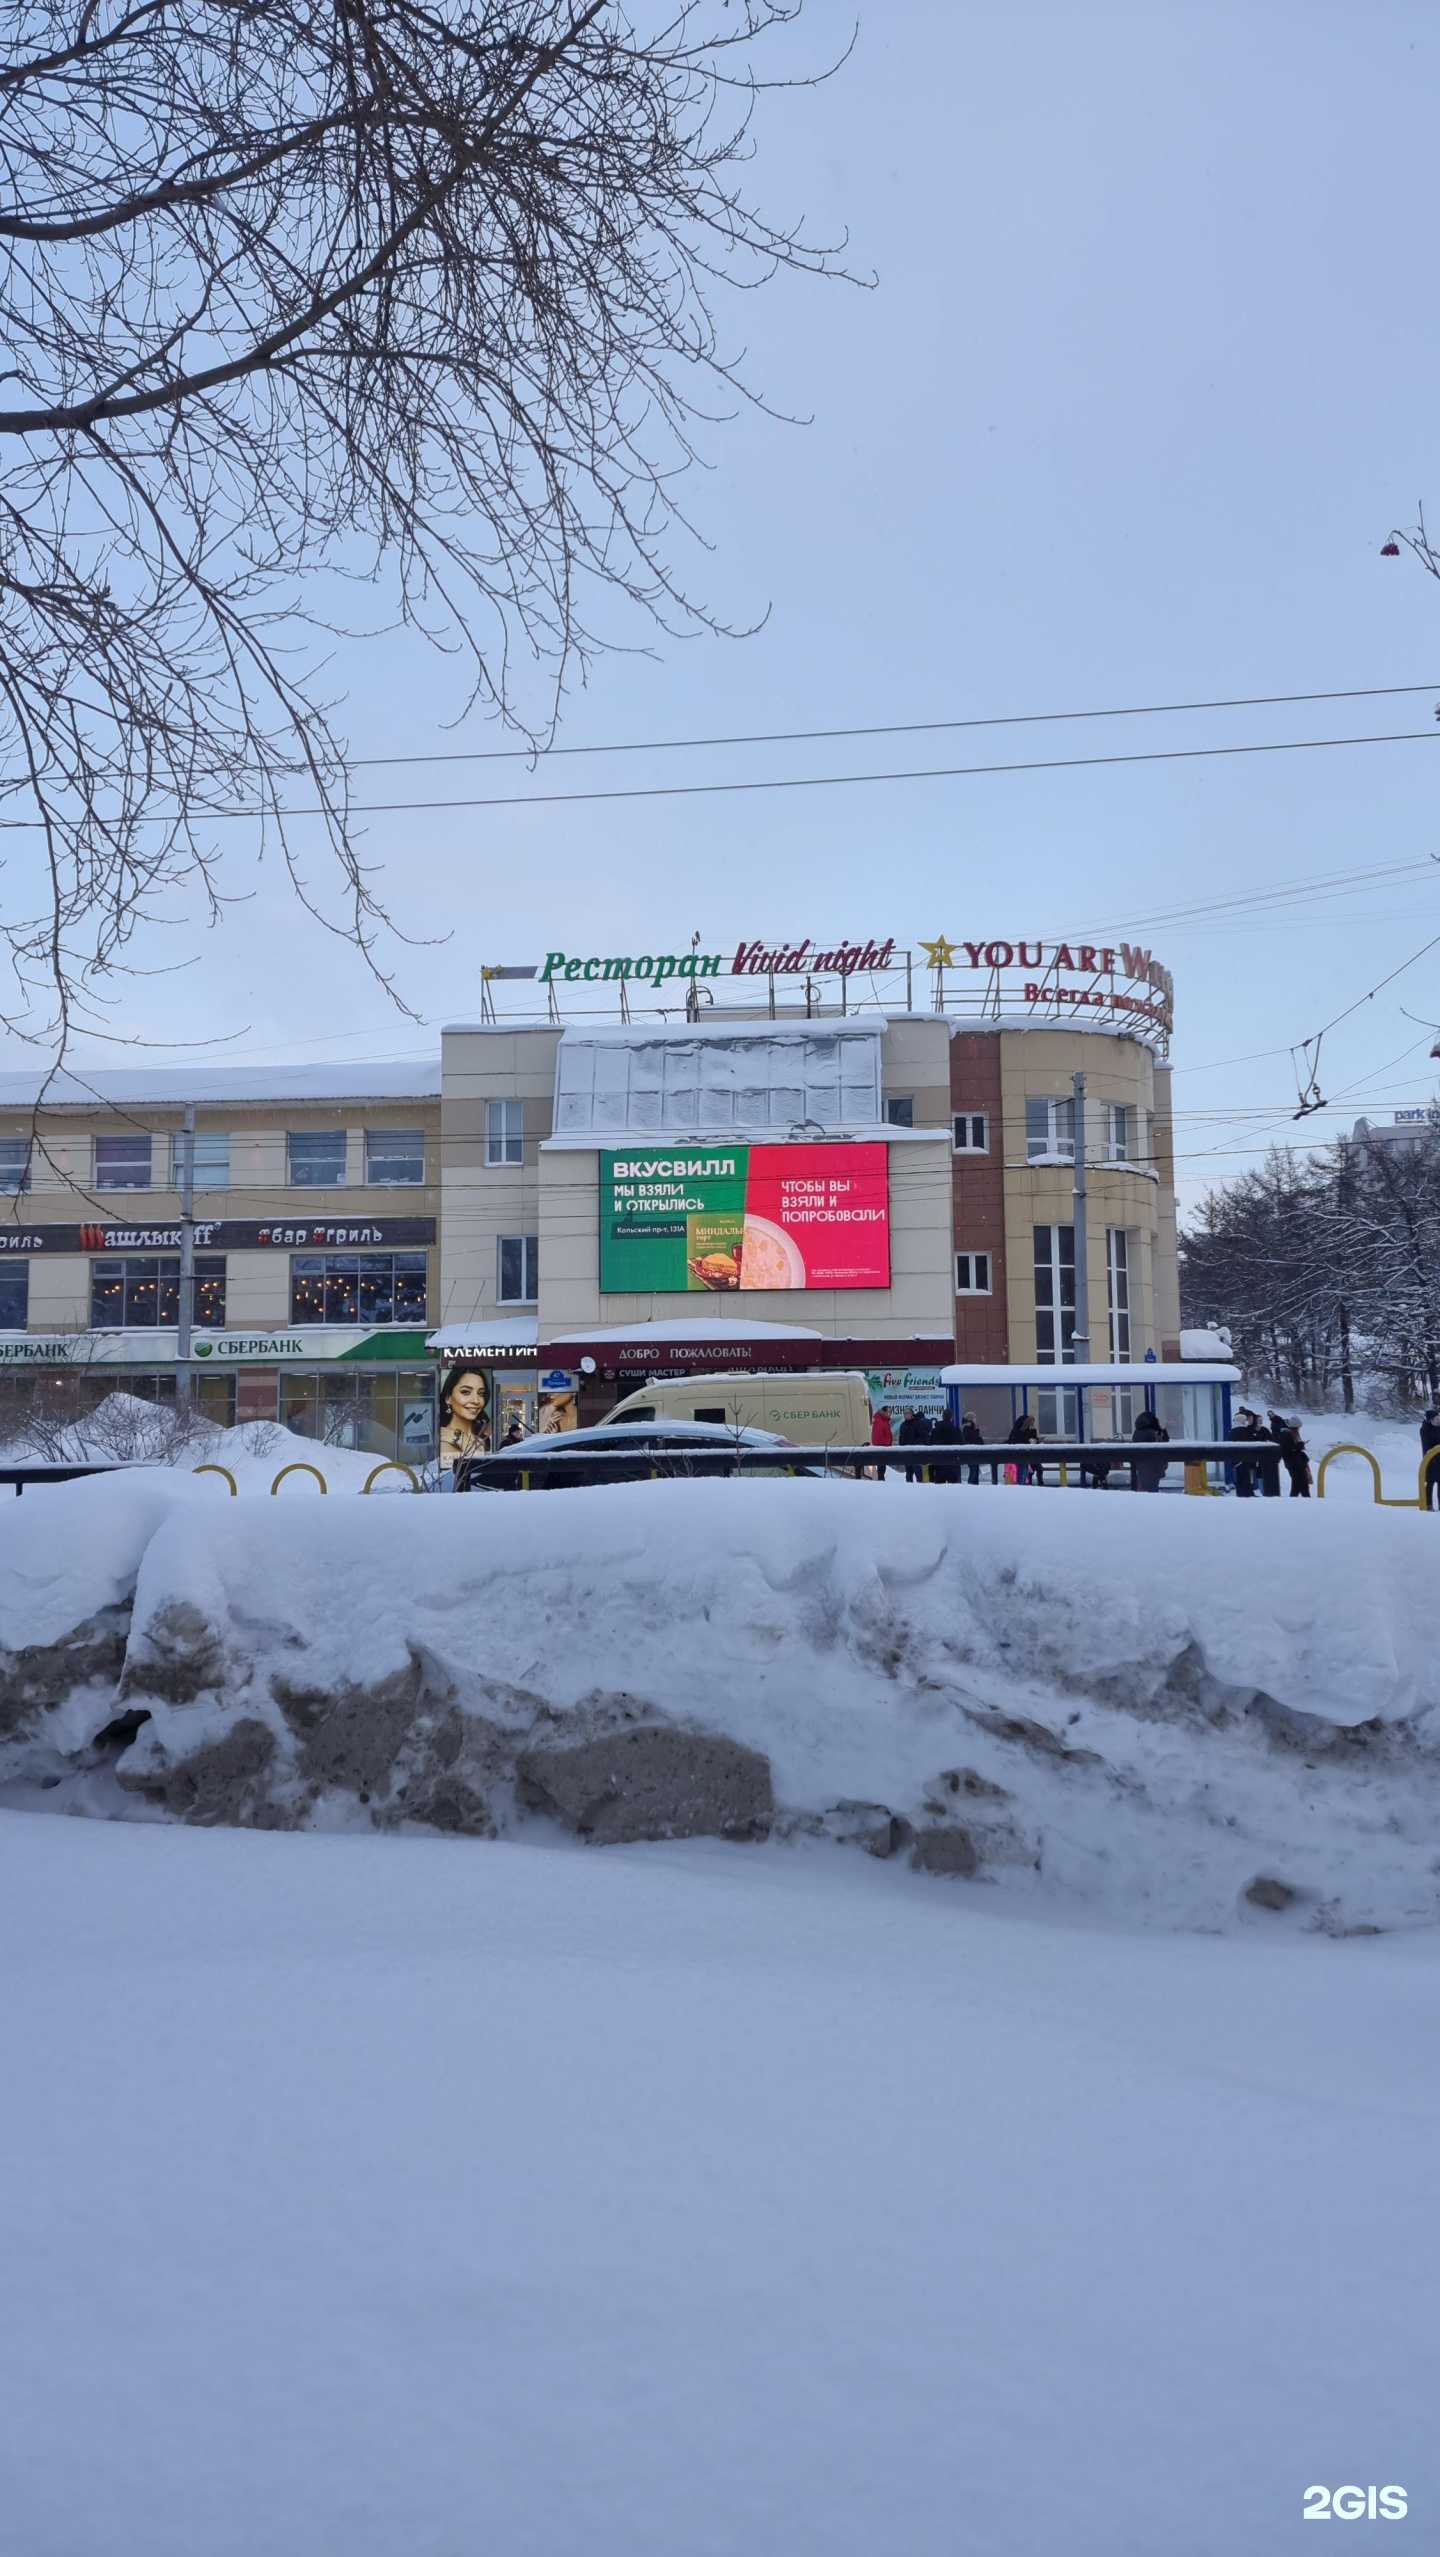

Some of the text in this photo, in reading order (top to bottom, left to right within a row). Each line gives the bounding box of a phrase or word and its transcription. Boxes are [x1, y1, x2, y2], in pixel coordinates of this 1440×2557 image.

[732, 937, 896, 976] Vivid night
[962, 940, 1042, 969] YOU
[1054, 943, 1115, 975] ARE
[538, 952, 721, 988] Ресторан
[613, 1159, 736, 1178] ВКУСВИЛЛ
[614, 1183, 684, 1197] МЫ ВЗЯЛИ
[781, 1180, 850, 1193] ЧТОБЫ ВЫ
[614, 1198, 705, 1212] И ОТКРЫЛИСЬ
[782, 1195, 838, 1208] ВЗЯЛИ И
[782, 1209, 886, 1223] ПОПРОБОВАЛИ
[271, 1227, 307, 1246] бар
[325, 1226, 383, 1244] гриль
[217, 1339, 304, 1354] СБЕРБАНК
[619, 1347, 752, 1359] ДОБРО ПОЖАЛОВАТЬ!
[619, 1369, 646, 1377] СУШИ
[650, 1369, 686, 1377] МАСТЕР
